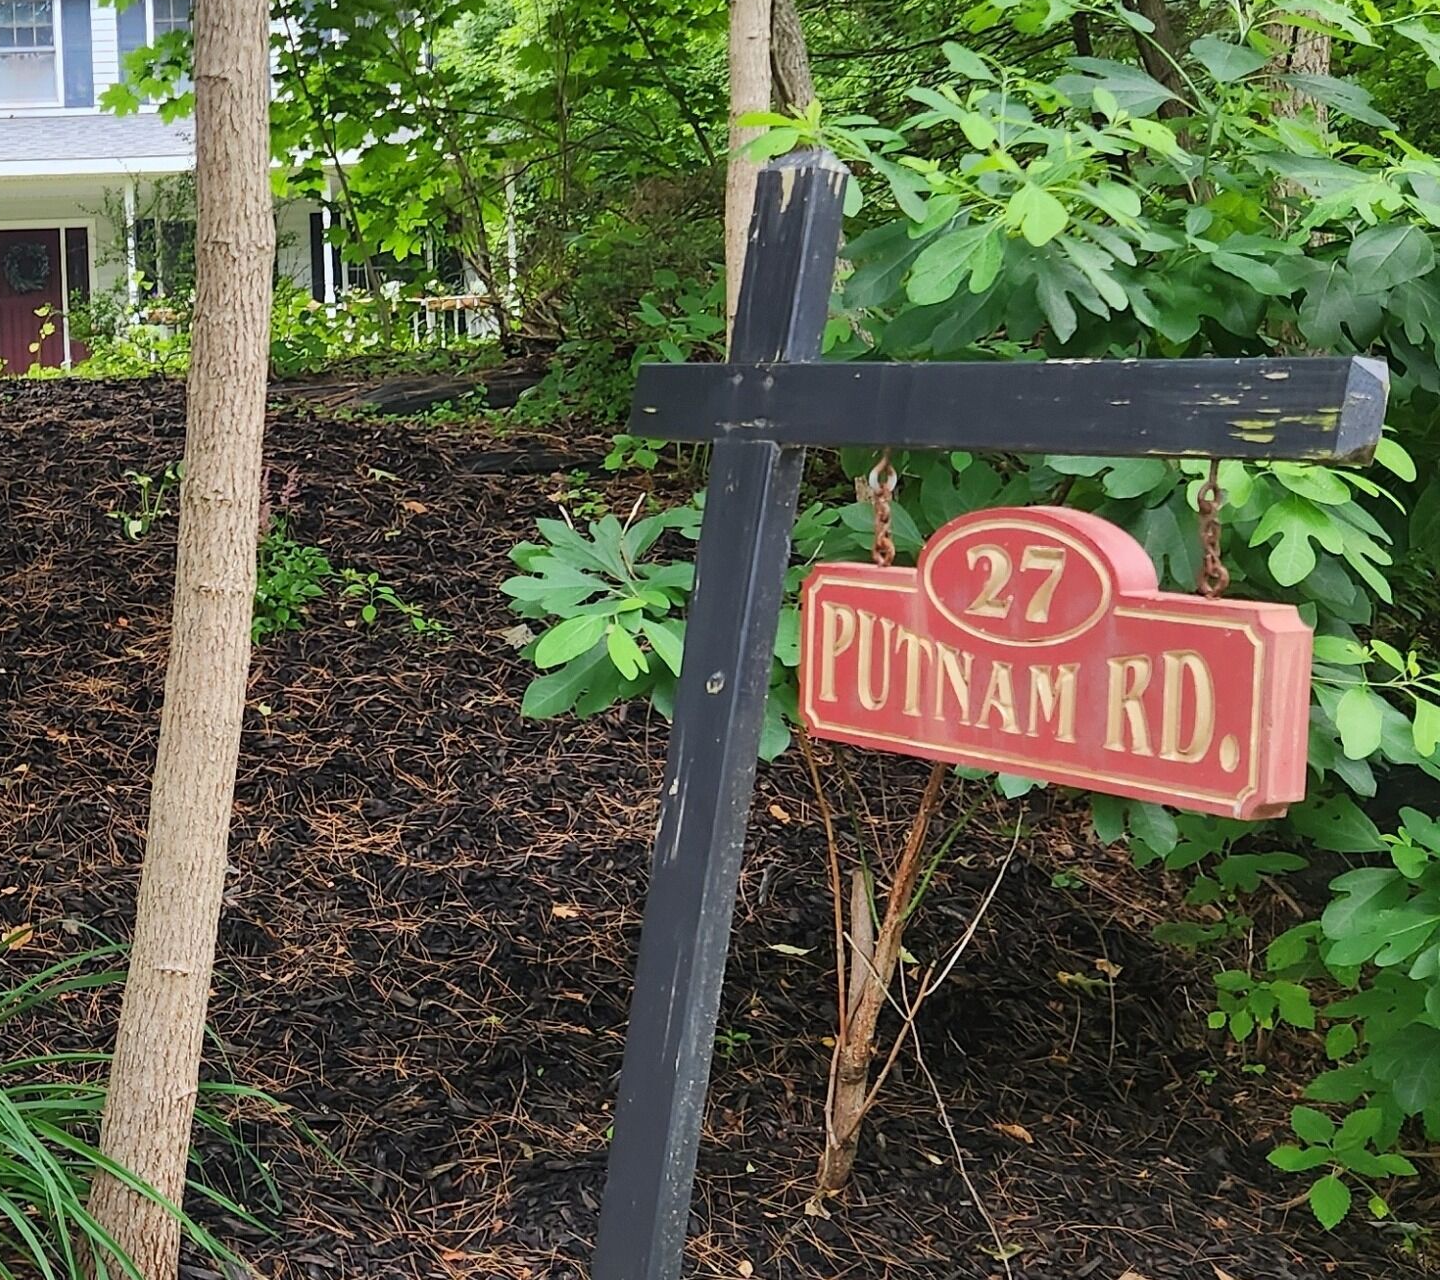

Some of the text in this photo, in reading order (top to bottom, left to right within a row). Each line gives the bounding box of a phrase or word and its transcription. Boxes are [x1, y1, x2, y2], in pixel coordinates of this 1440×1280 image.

[965, 543, 1066, 624] 27
[818, 600, 1241, 774] PUTNAM RD.
